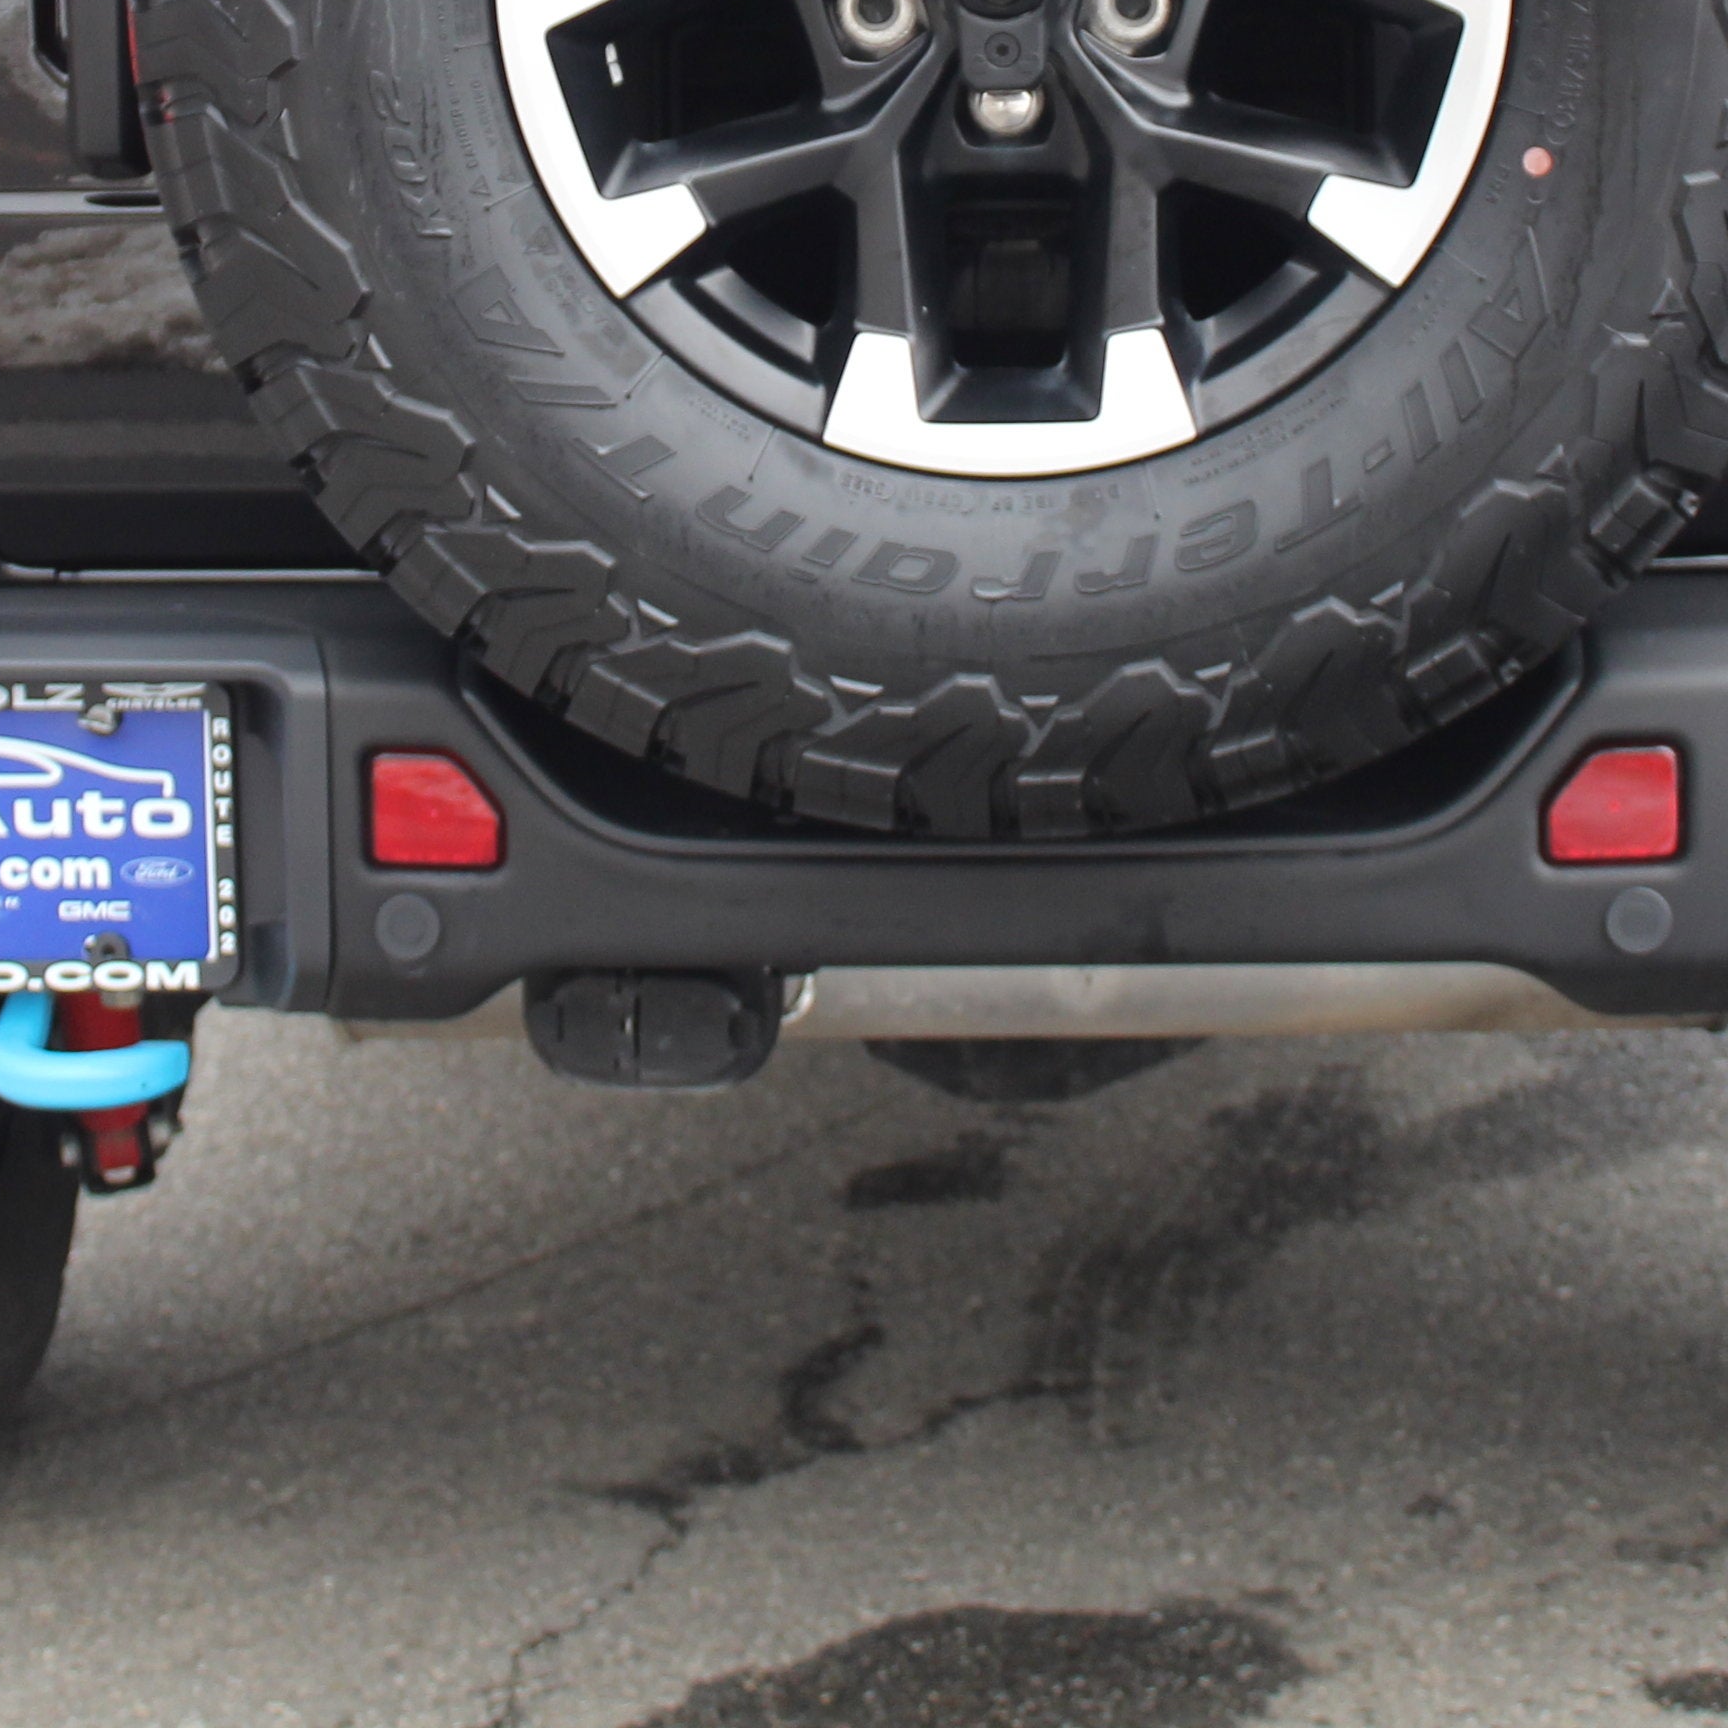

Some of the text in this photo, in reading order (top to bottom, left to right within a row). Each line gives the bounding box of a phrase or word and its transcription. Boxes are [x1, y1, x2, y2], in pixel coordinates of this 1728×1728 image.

[212, 716, 238, 956] ROUTE 202
[57, 899, 132, 922] GMC
